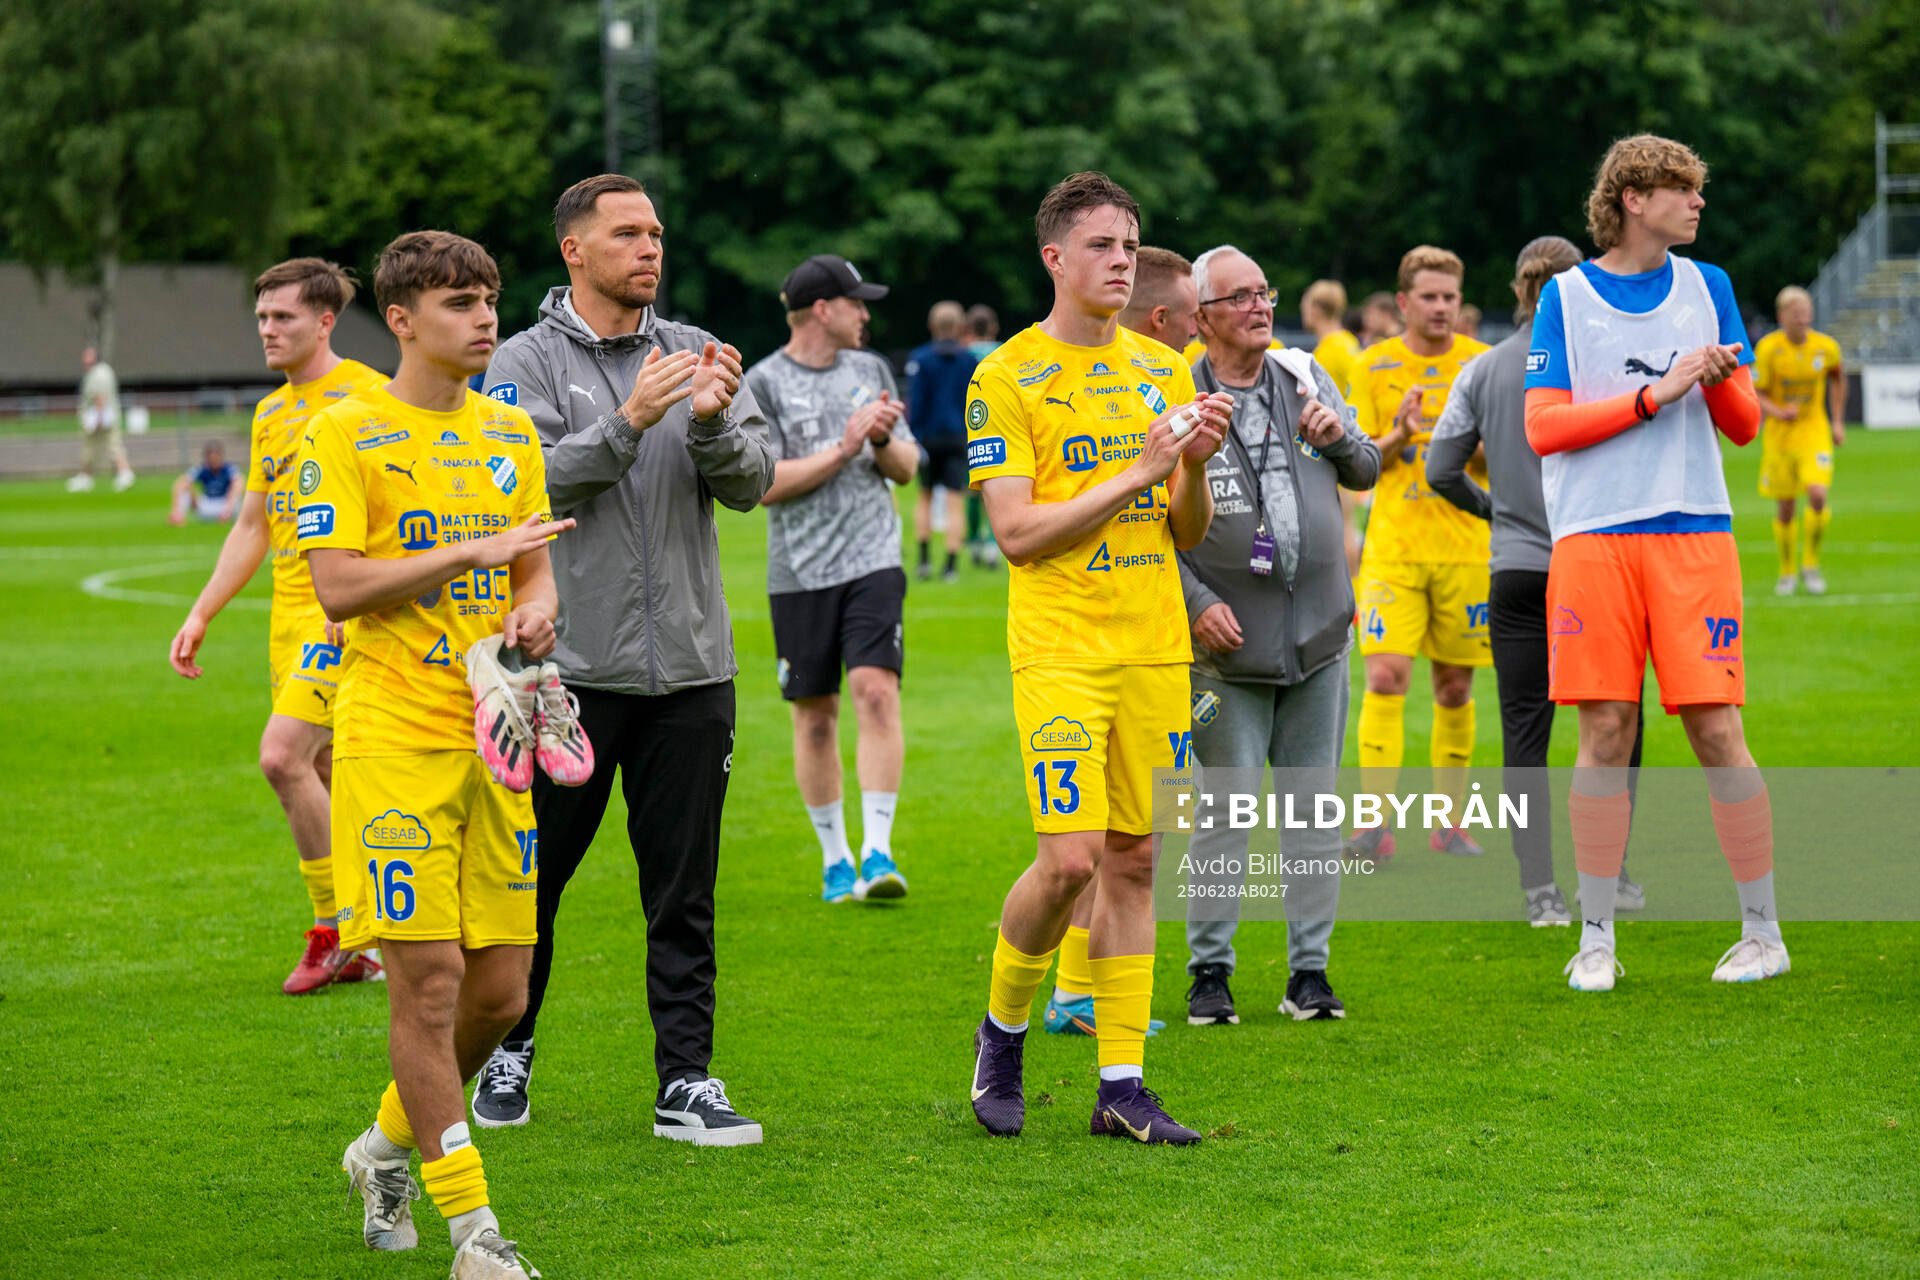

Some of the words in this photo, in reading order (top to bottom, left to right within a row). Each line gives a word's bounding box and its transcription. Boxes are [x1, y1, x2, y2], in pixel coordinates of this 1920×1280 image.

[1102, 448, 1144, 462] GRUP
[442, 458, 480, 468] ANACKA
[442, 531, 502, 543] GRUPP
[1115, 554, 1165, 568] FYRSTA
[1705, 617, 1739, 650] YP
[301, 643, 343, 671] YP
[1042, 731, 1082, 743] SESAB
[1033, 760, 1080, 815] 13
[373, 827, 416, 840] SESAB
[368, 859, 416, 920] 16
